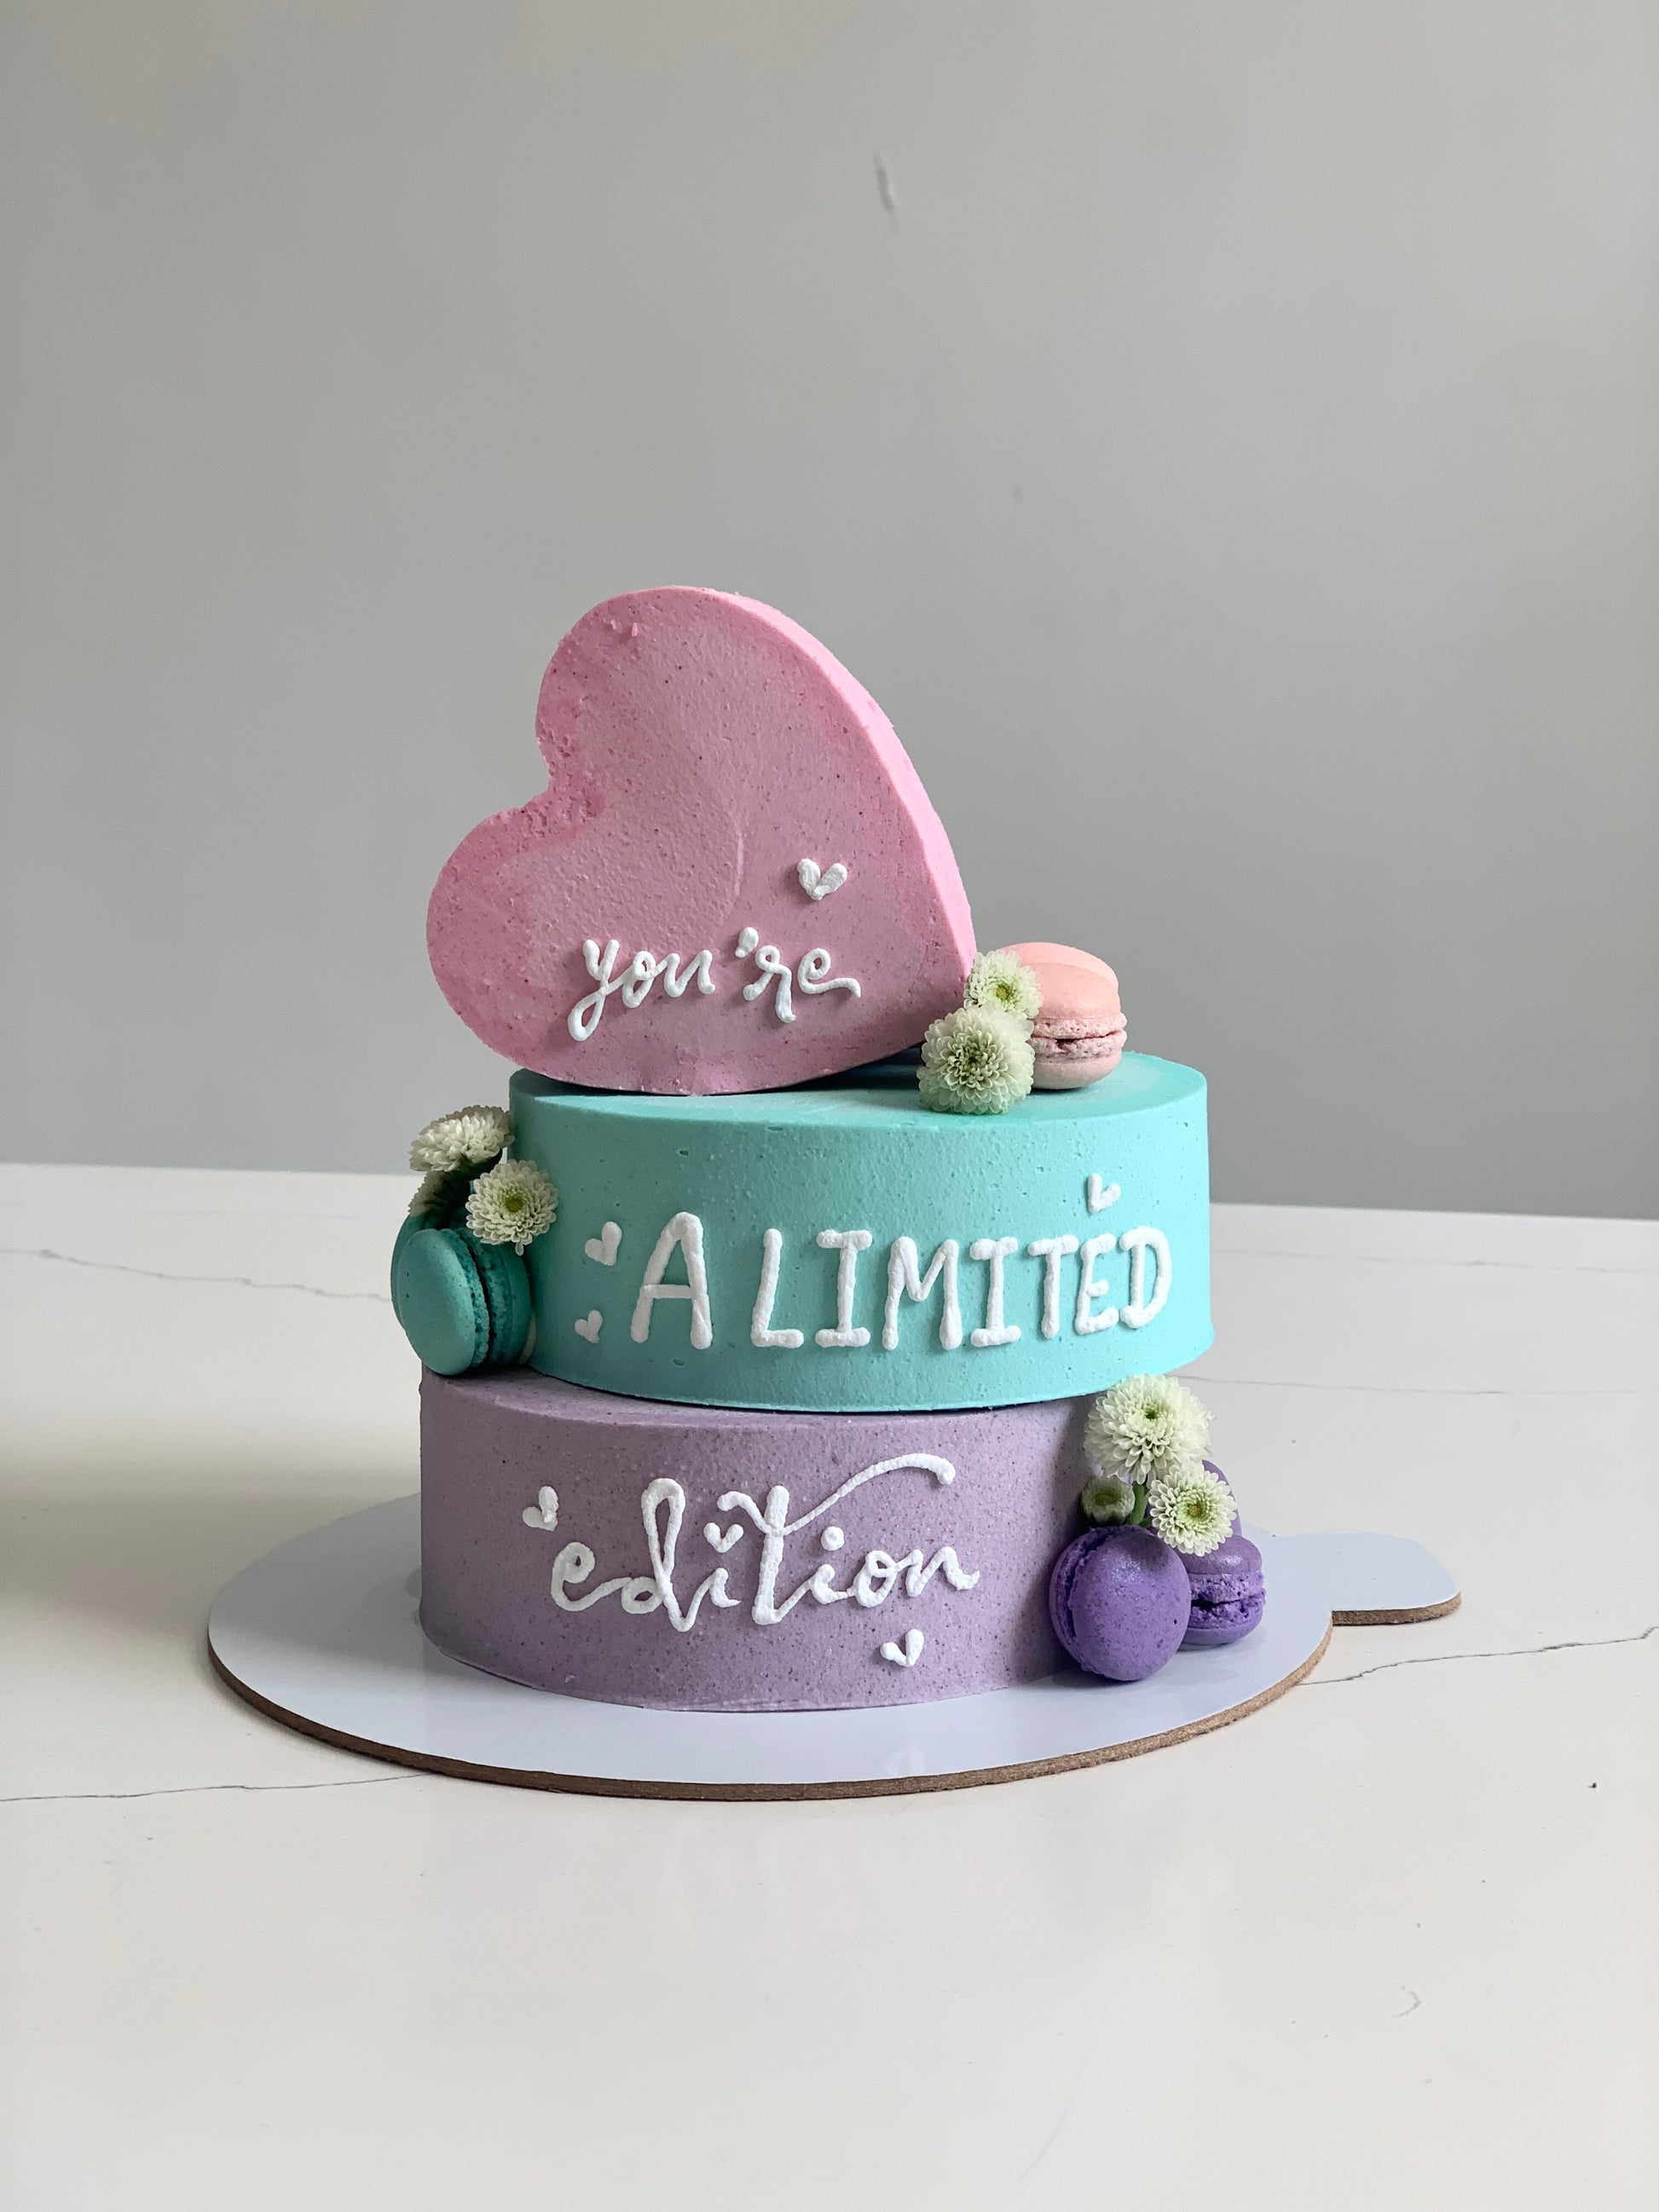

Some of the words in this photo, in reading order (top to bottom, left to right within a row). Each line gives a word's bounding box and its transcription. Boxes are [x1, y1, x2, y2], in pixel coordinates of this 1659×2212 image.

[567, 927, 862, 1042] you're
[630, 1211, 714, 1350] A
[750, 1225, 1172, 1350] LIMITED
[550, 1453, 981, 1632] edition
